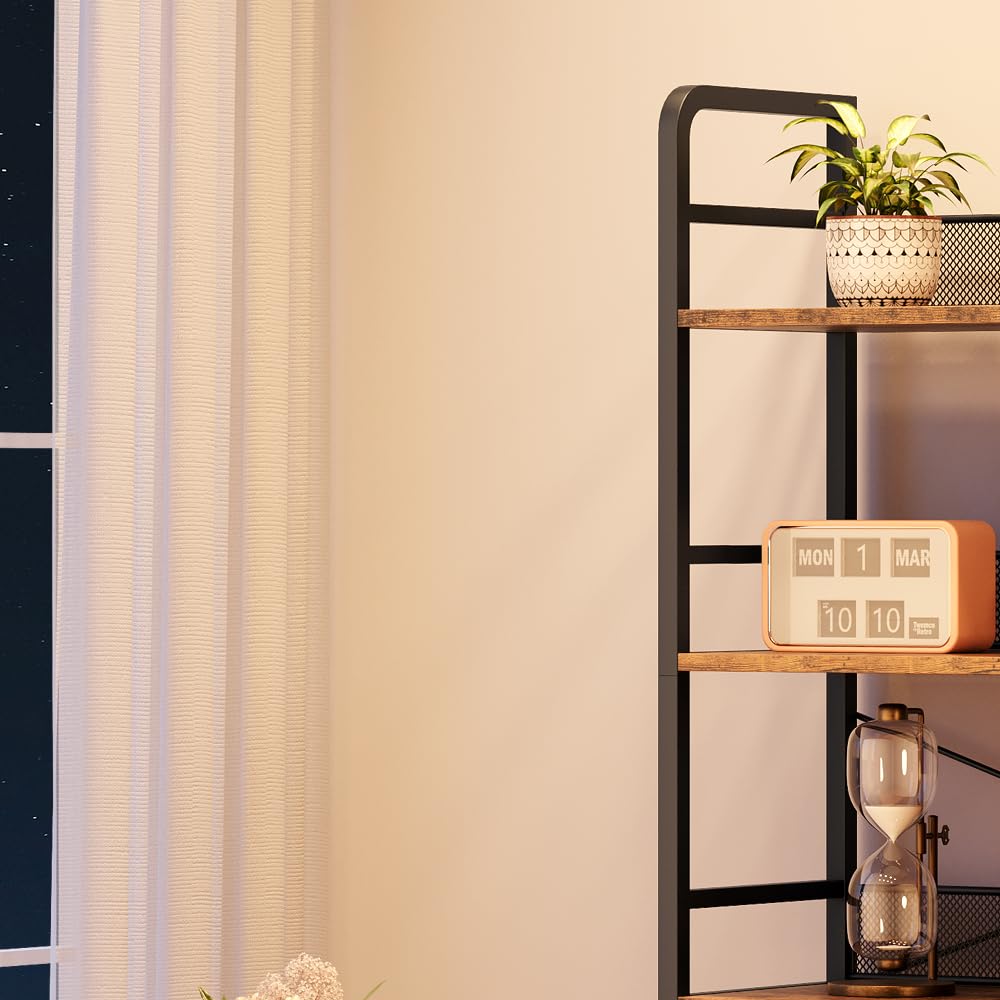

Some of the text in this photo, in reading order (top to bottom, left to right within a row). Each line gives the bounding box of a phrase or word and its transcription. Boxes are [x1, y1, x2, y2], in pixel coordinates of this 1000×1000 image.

[799, 549, 833, 566] MON
[857, 544, 866, 571] 1
[896, 550, 930, 566] MAR
[825, 608, 851, 632] 10
[873, 608, 900, 633] 10
